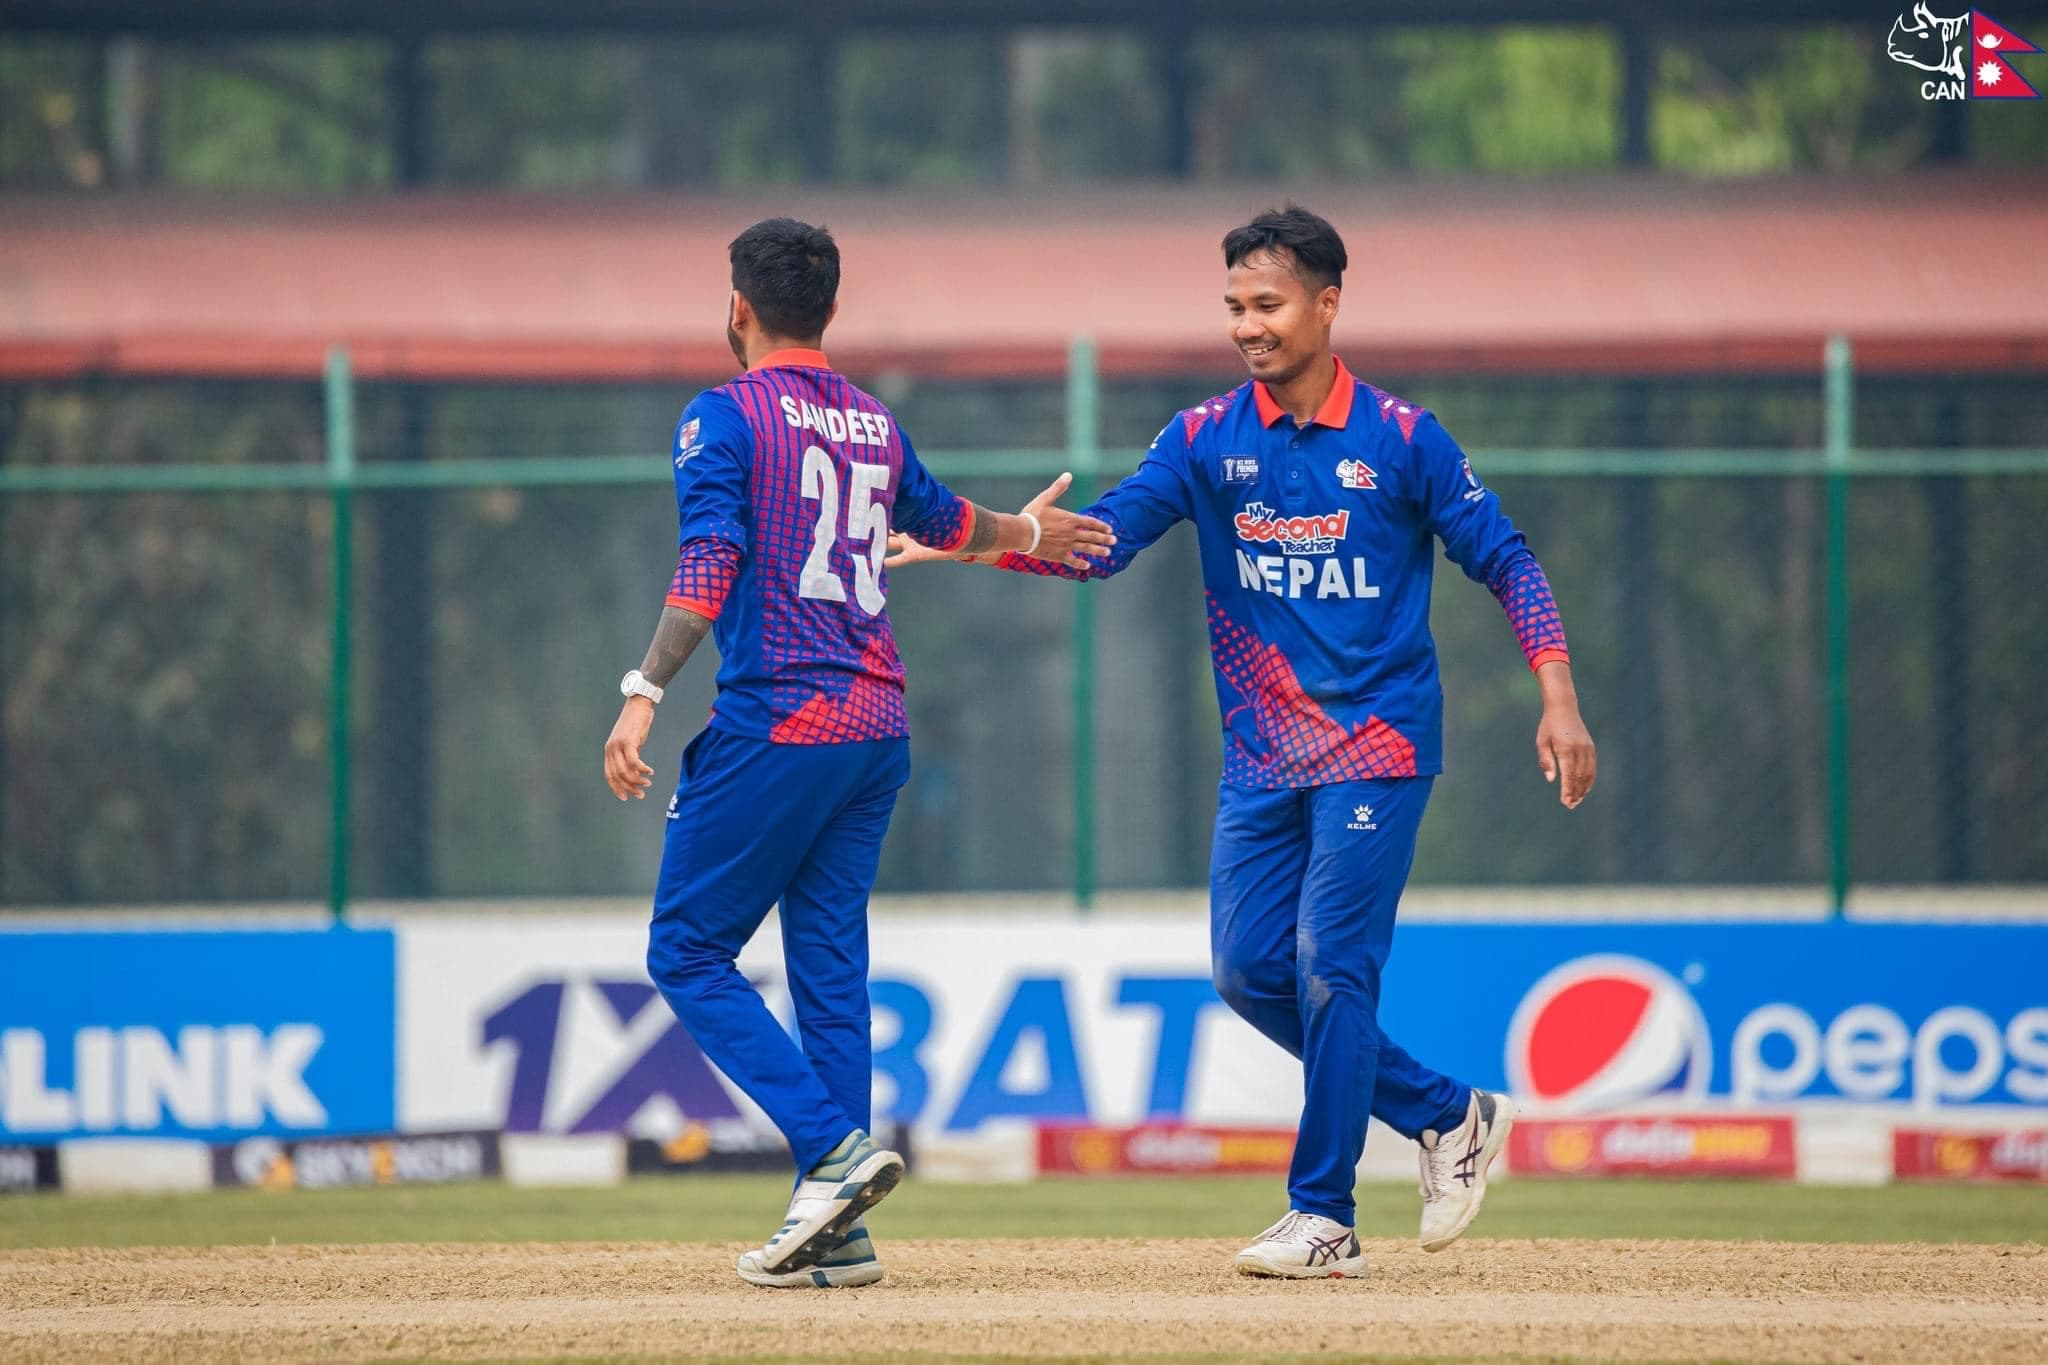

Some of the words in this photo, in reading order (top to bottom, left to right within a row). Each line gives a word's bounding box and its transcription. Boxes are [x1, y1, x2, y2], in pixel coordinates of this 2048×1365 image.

[780, 395, 890, 447] SANDEEP
[799, 445, 890, 616] 25
[1235, 510, 1348, 542] Second
[1247, 502, 1275, 520] My
[1283, 538, 1334, 554] Teacher
[1235, 549, 1380, 599] NEPAL
[0, 1023, 328, 1132] LINK
